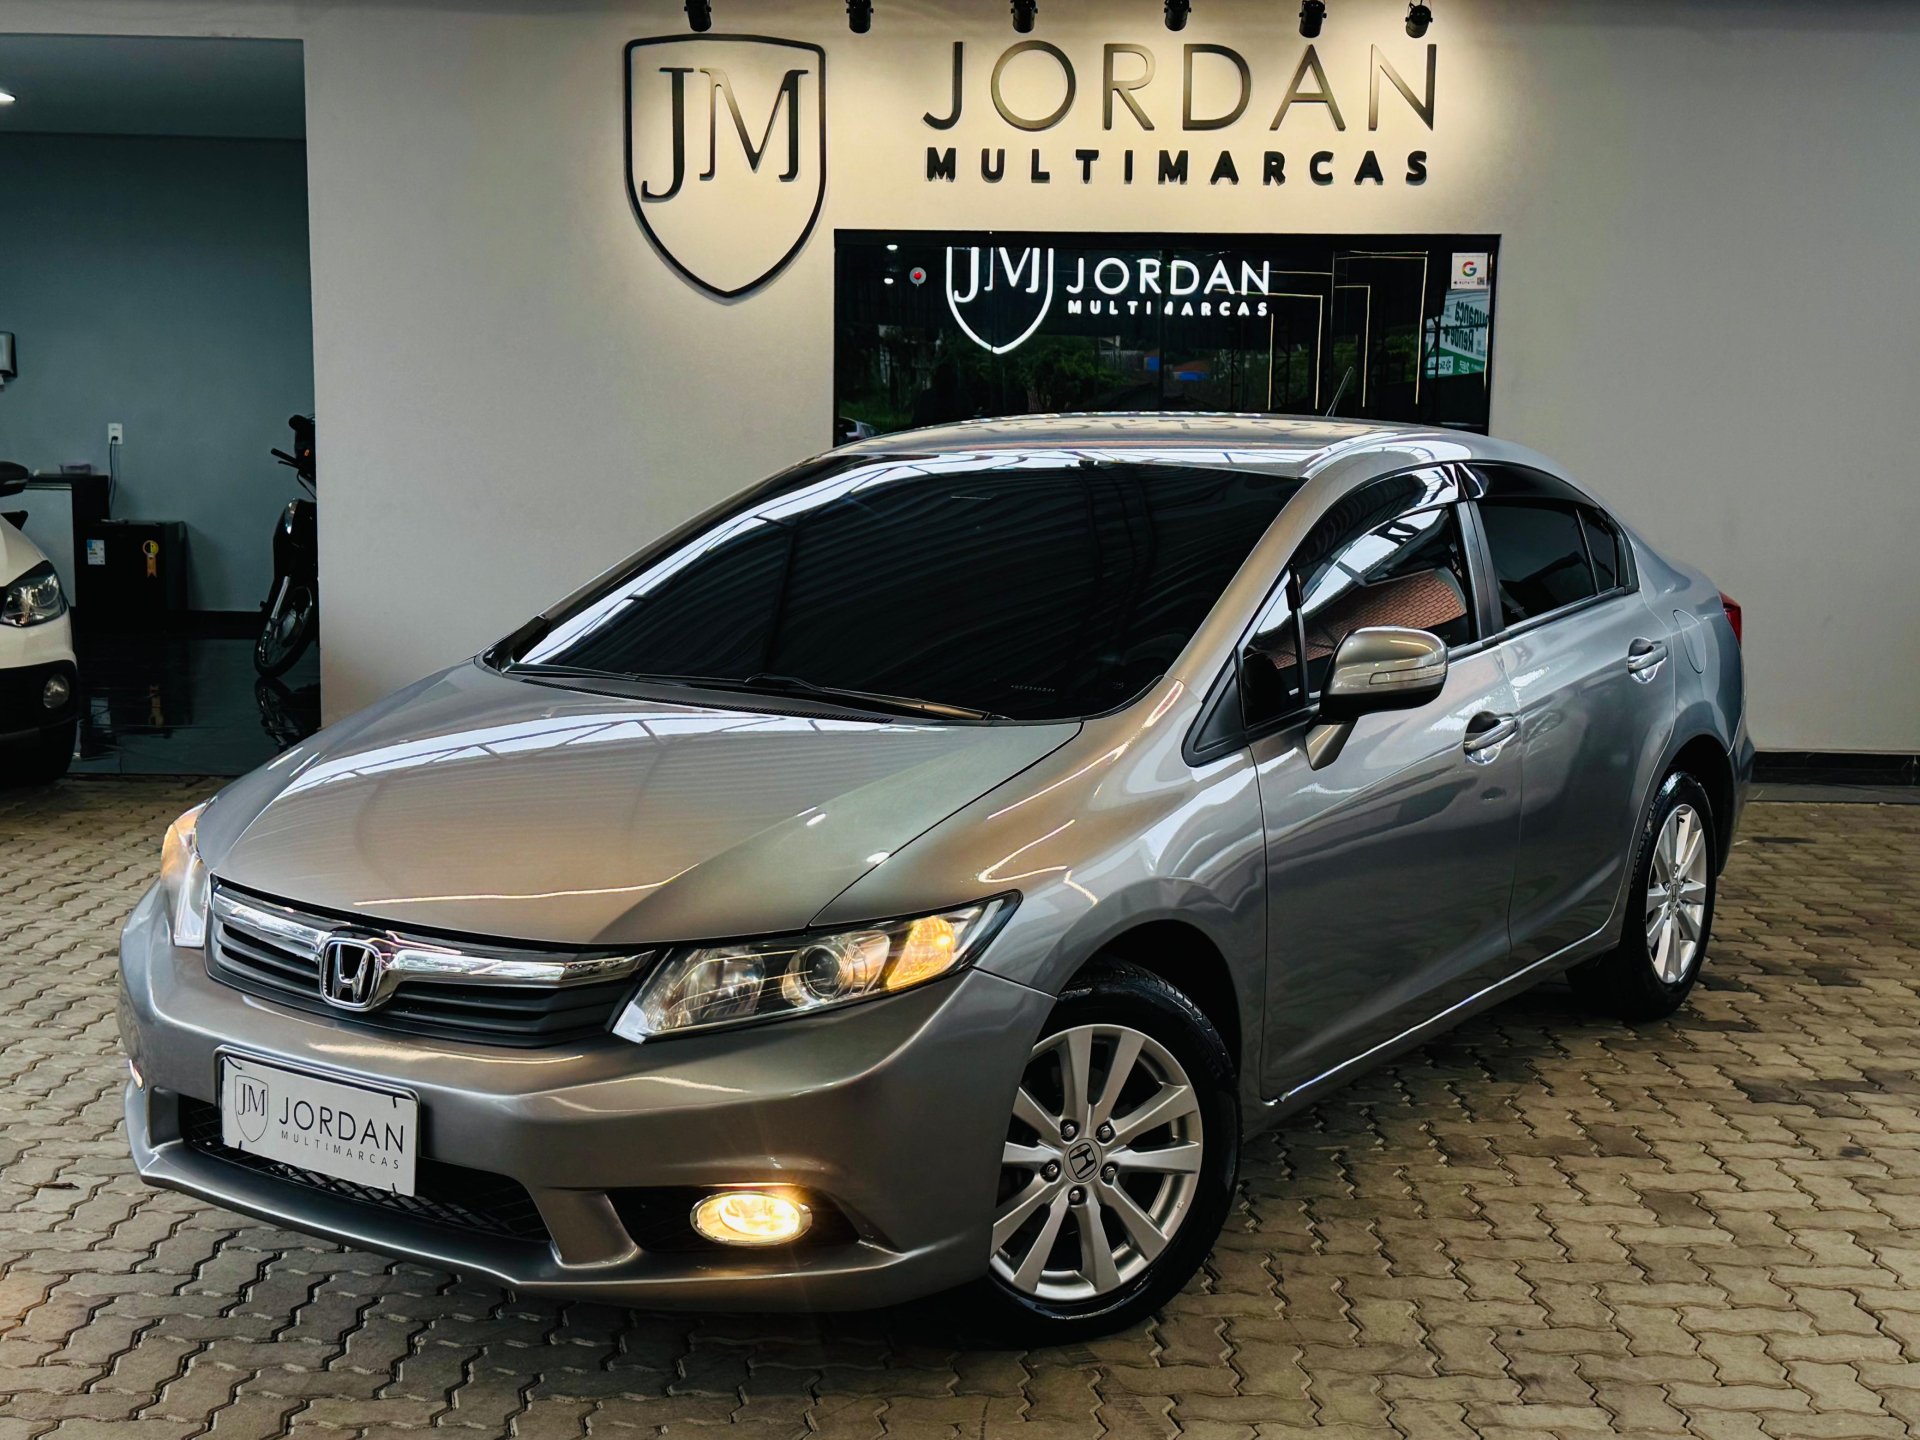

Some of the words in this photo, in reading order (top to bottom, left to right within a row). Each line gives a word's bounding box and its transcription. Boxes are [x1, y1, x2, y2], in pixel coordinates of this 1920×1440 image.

[922, 40, 1436, 132] JORDAN
[641, 67, 809, 202] JM
[926, 147, 1429, 186] MULTIMARCAS
[953, 246, 1041, 303] JM
[1065, 257, 1271, 297] JORDAN
[1067, 299, 1269, 317] MULTIMARCAS
[237, 1083, 267, 1117] JM
[278, 1096, 405, 1155] JORDAN
[281, 1129, 400, 1170] MULTIMARCAS
